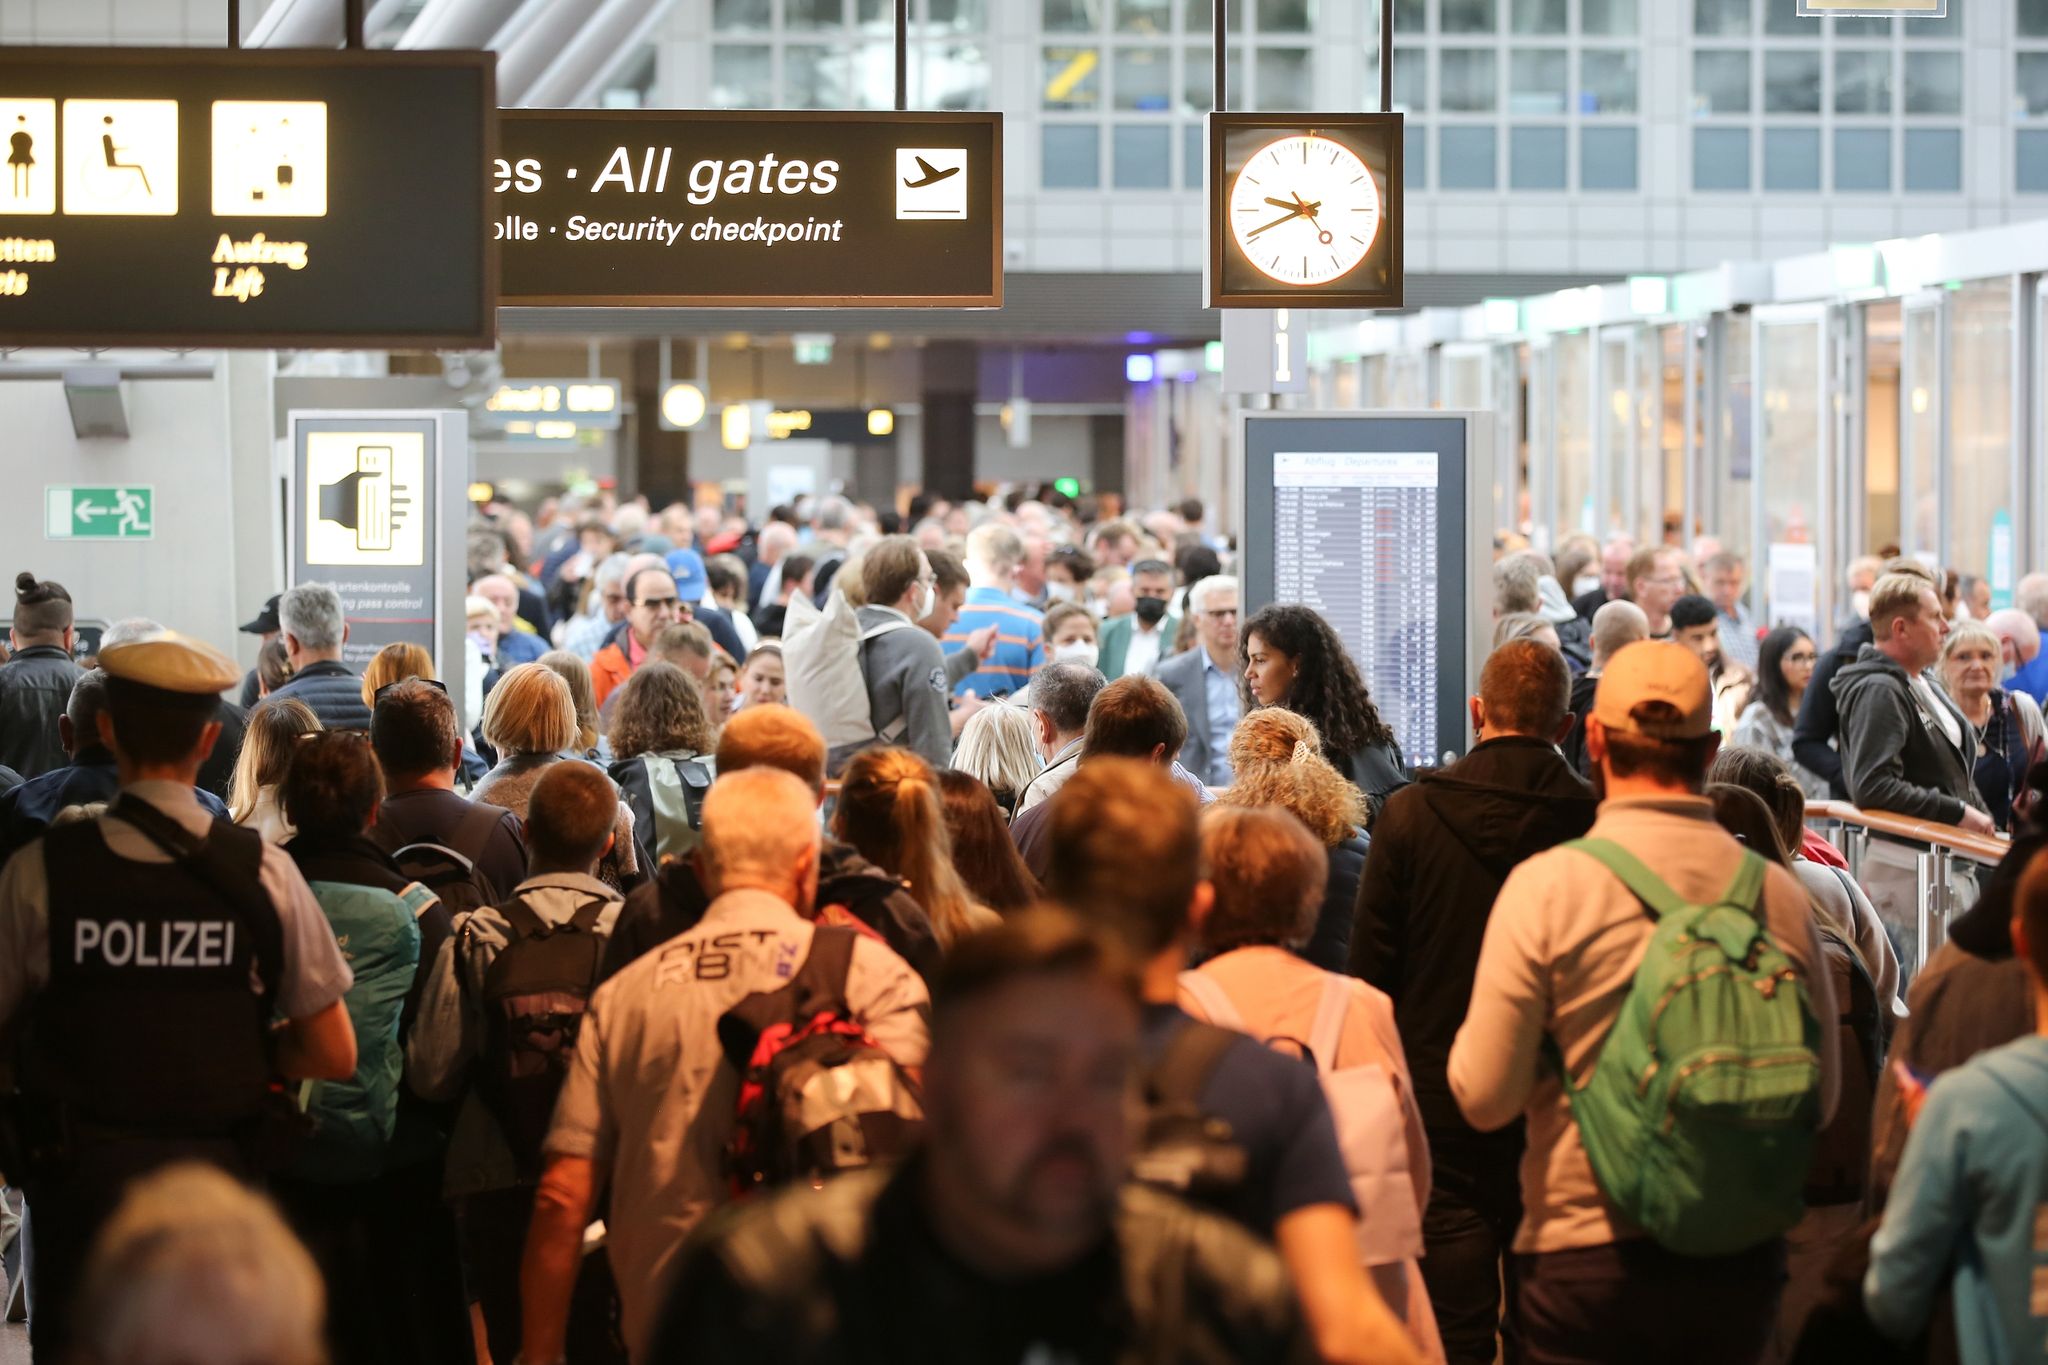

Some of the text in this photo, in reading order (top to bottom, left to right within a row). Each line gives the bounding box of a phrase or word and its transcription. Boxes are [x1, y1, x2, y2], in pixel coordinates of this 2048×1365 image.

[494, 147, 840, 205] es All gates
[494, 215, 844, 247] olle Security checkpoint
[211, 266, 265, 303] Lift
[358, 600, 383, 610] pass
[384, 597, 424, 610] control
[74, 919, 235, 967] POLIZEI
